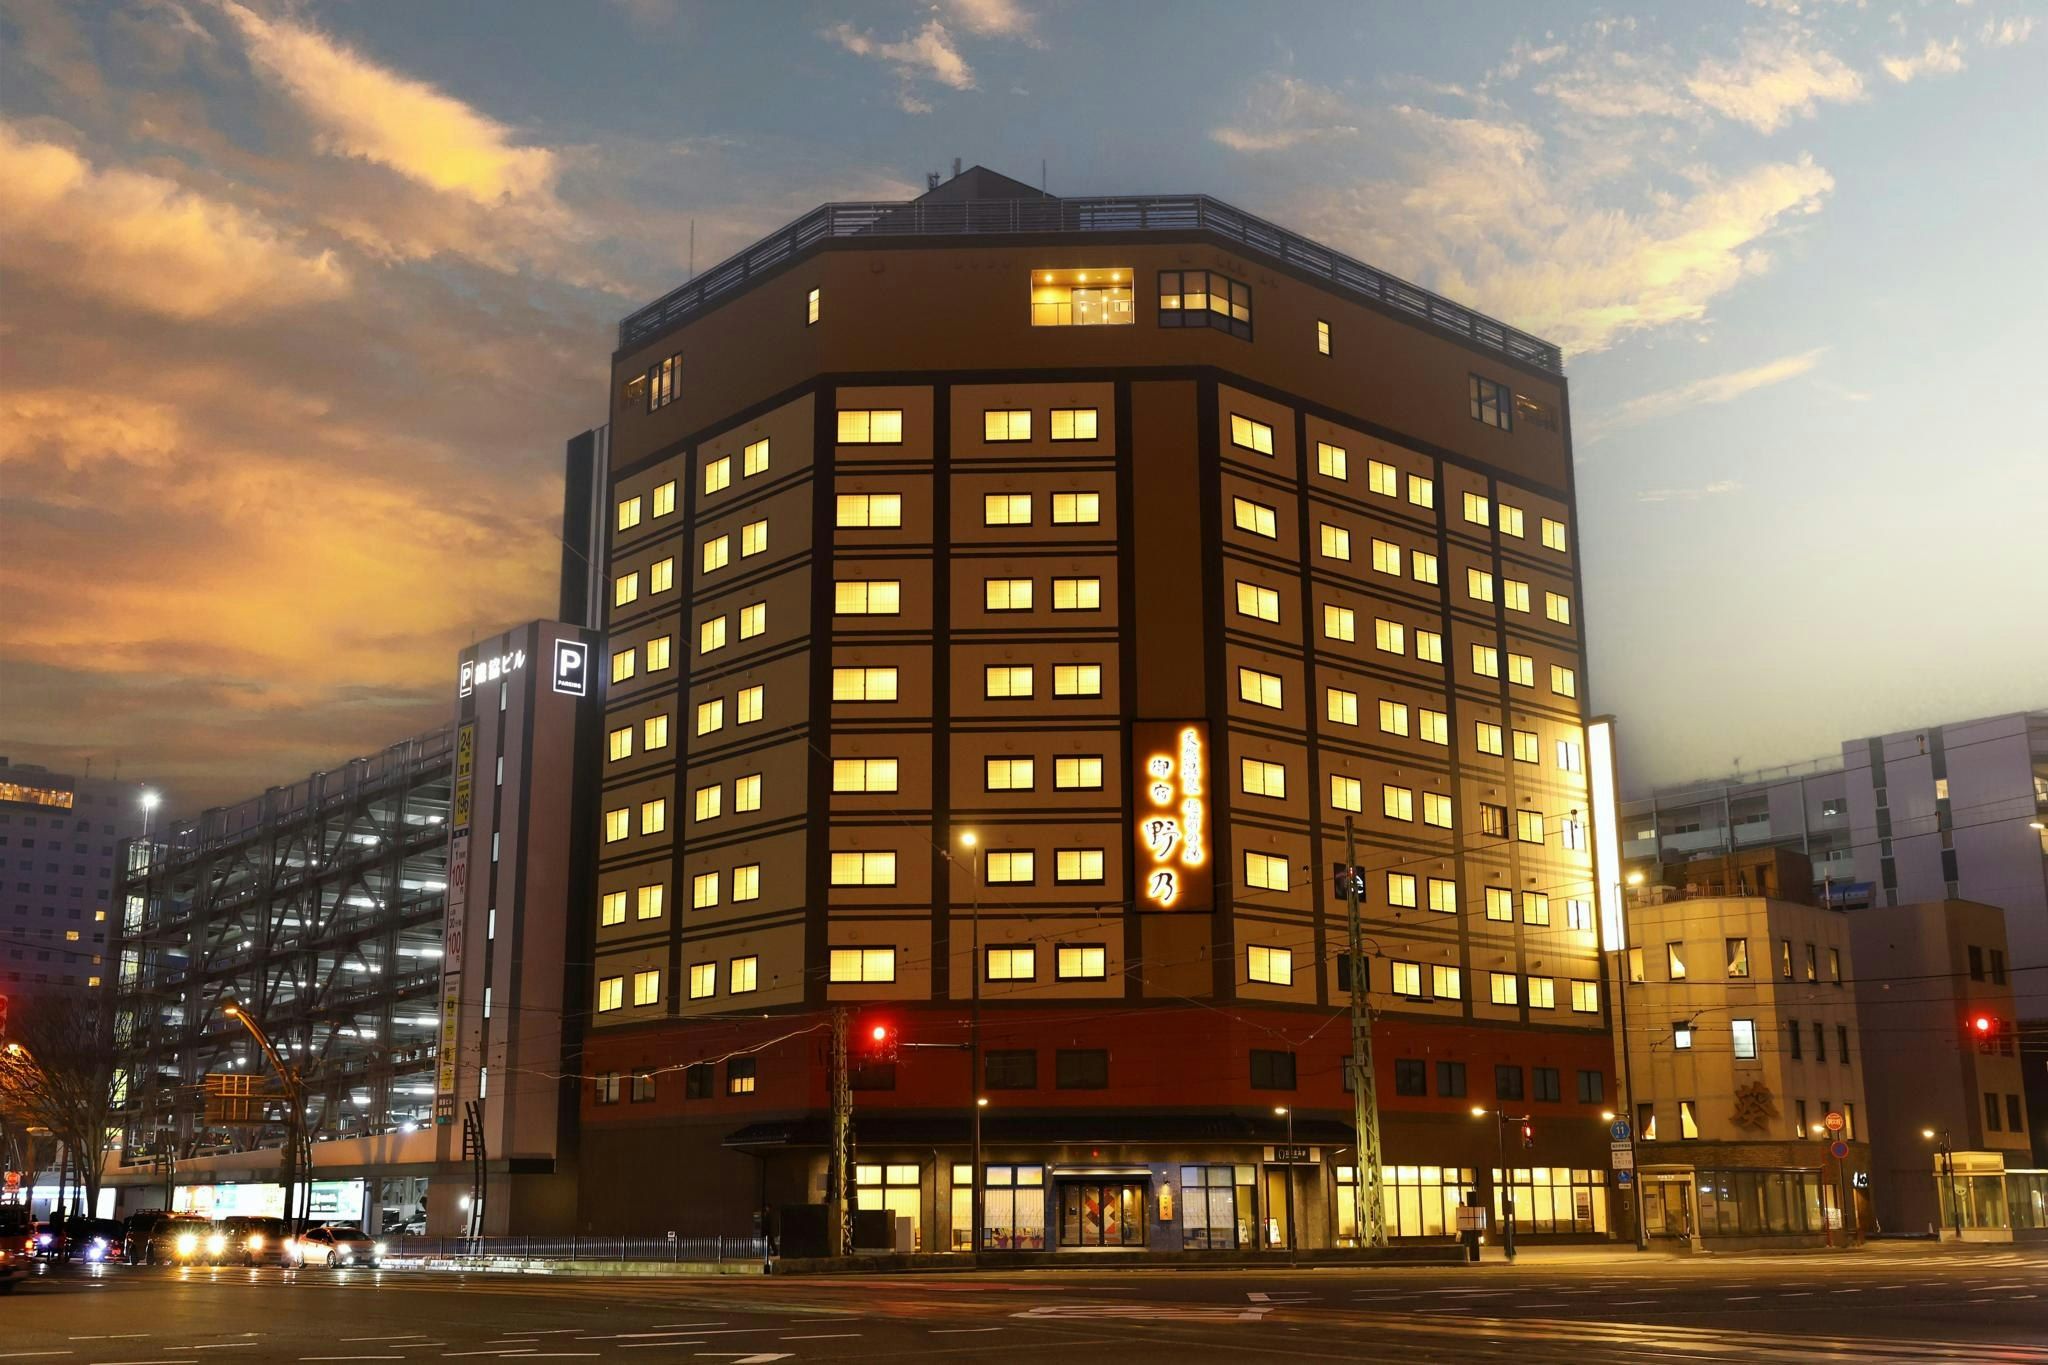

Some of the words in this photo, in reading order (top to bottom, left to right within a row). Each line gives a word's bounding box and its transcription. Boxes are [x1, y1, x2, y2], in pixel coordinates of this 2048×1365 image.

[560, 648, 581, 677] P
[557, 679, 582, 689] PARKING
[451, 863, 465, 888] 100
[448, 931, 461, 956] 100
[1615, 1126, 1625, 1135] 11
